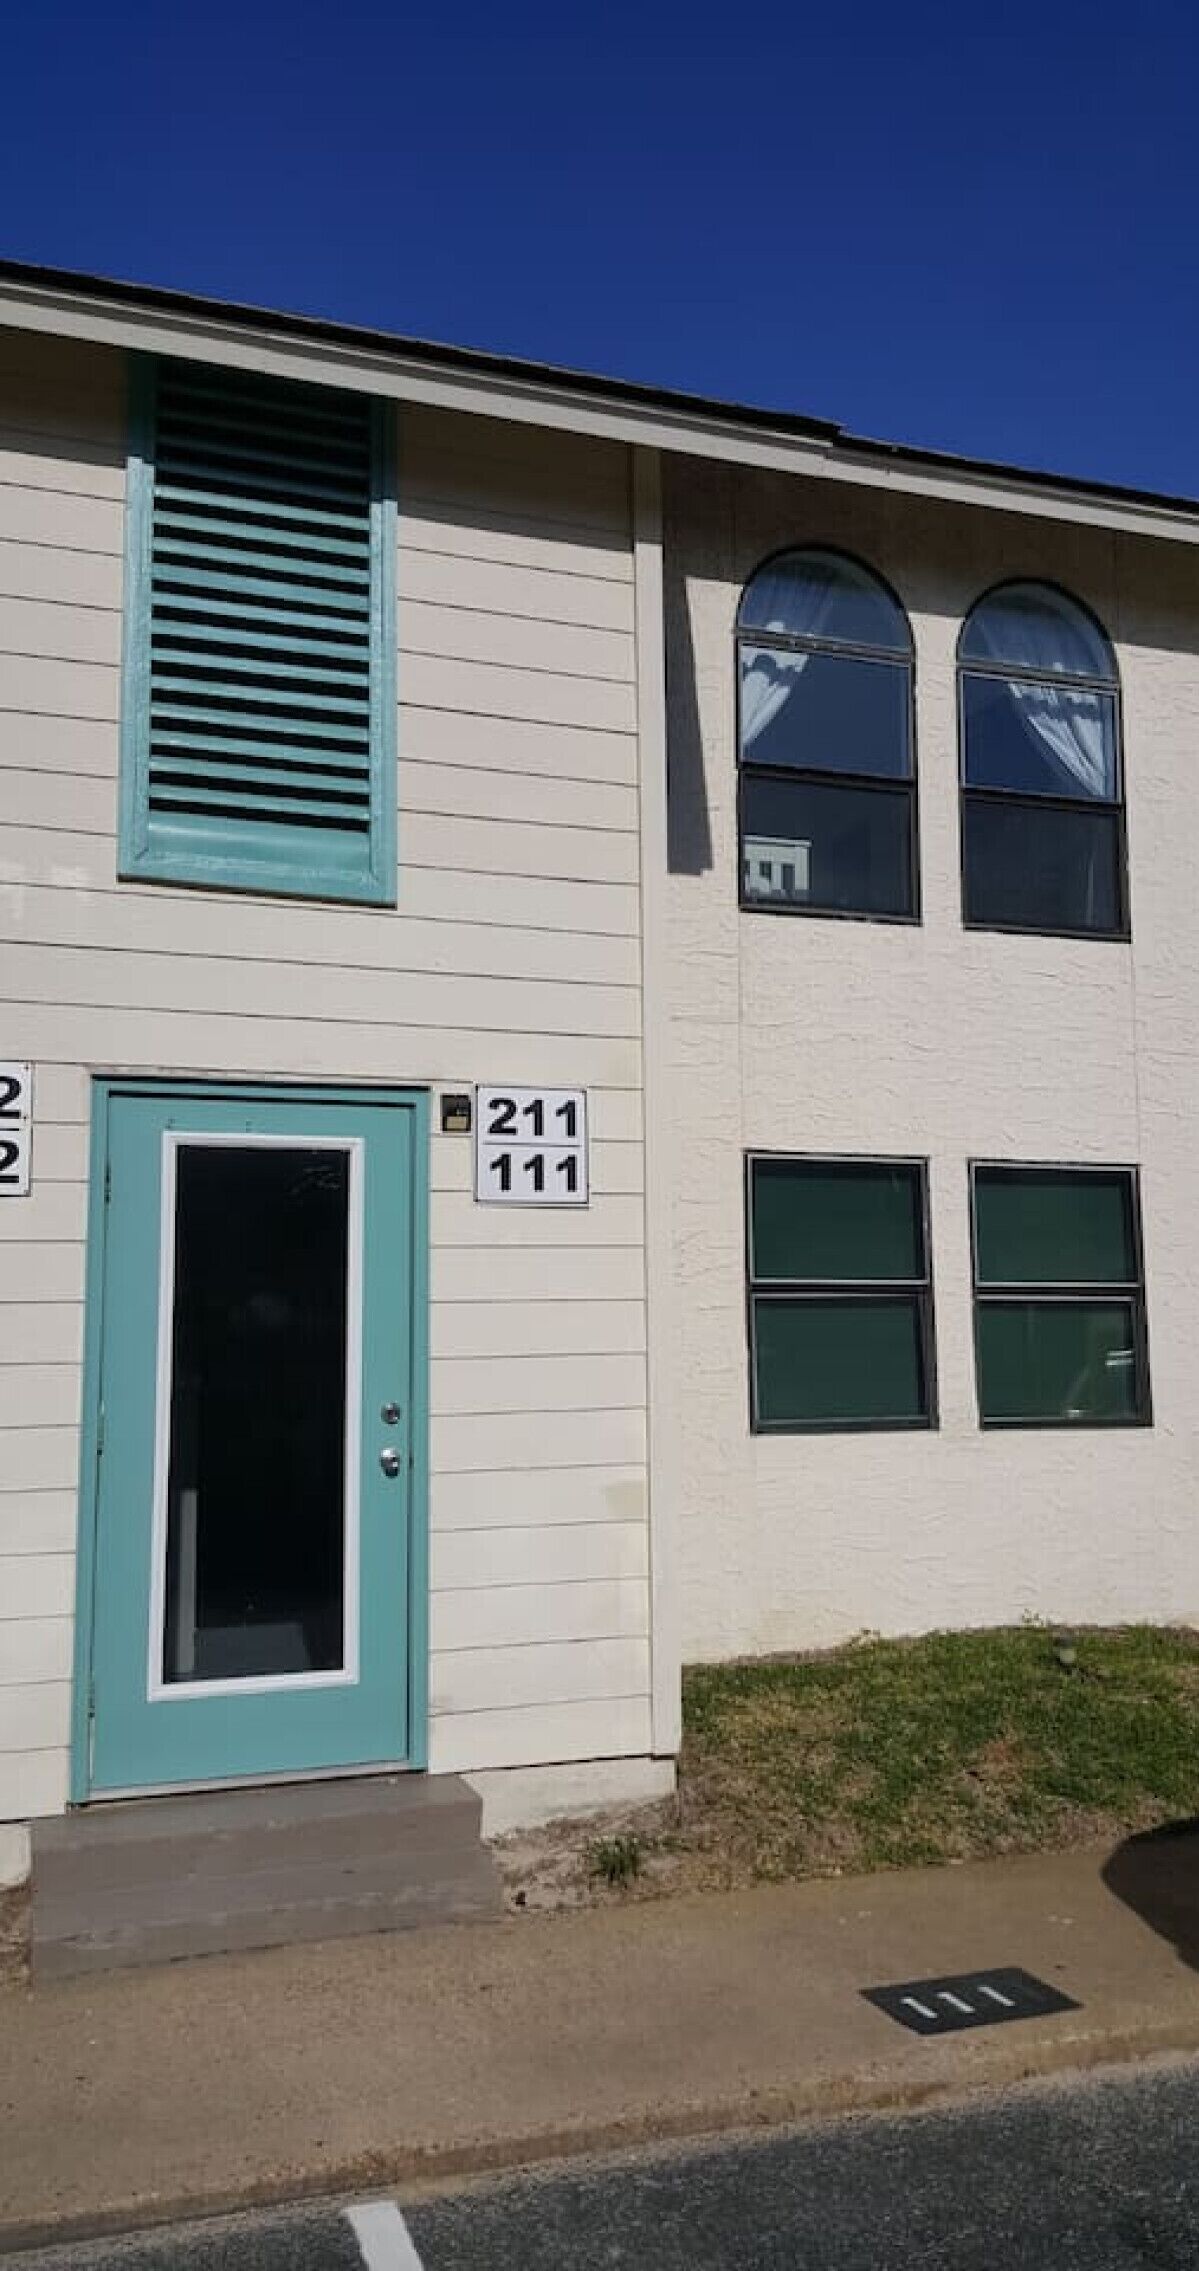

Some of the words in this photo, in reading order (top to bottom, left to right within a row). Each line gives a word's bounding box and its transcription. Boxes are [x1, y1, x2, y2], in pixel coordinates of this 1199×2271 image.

[0, 1076, 21, 1120] 2
[488, 1098, 577, 1137] 211
[489, 1154, 578, 1193] 111
[901, 1986, 1015, 2019] 111
